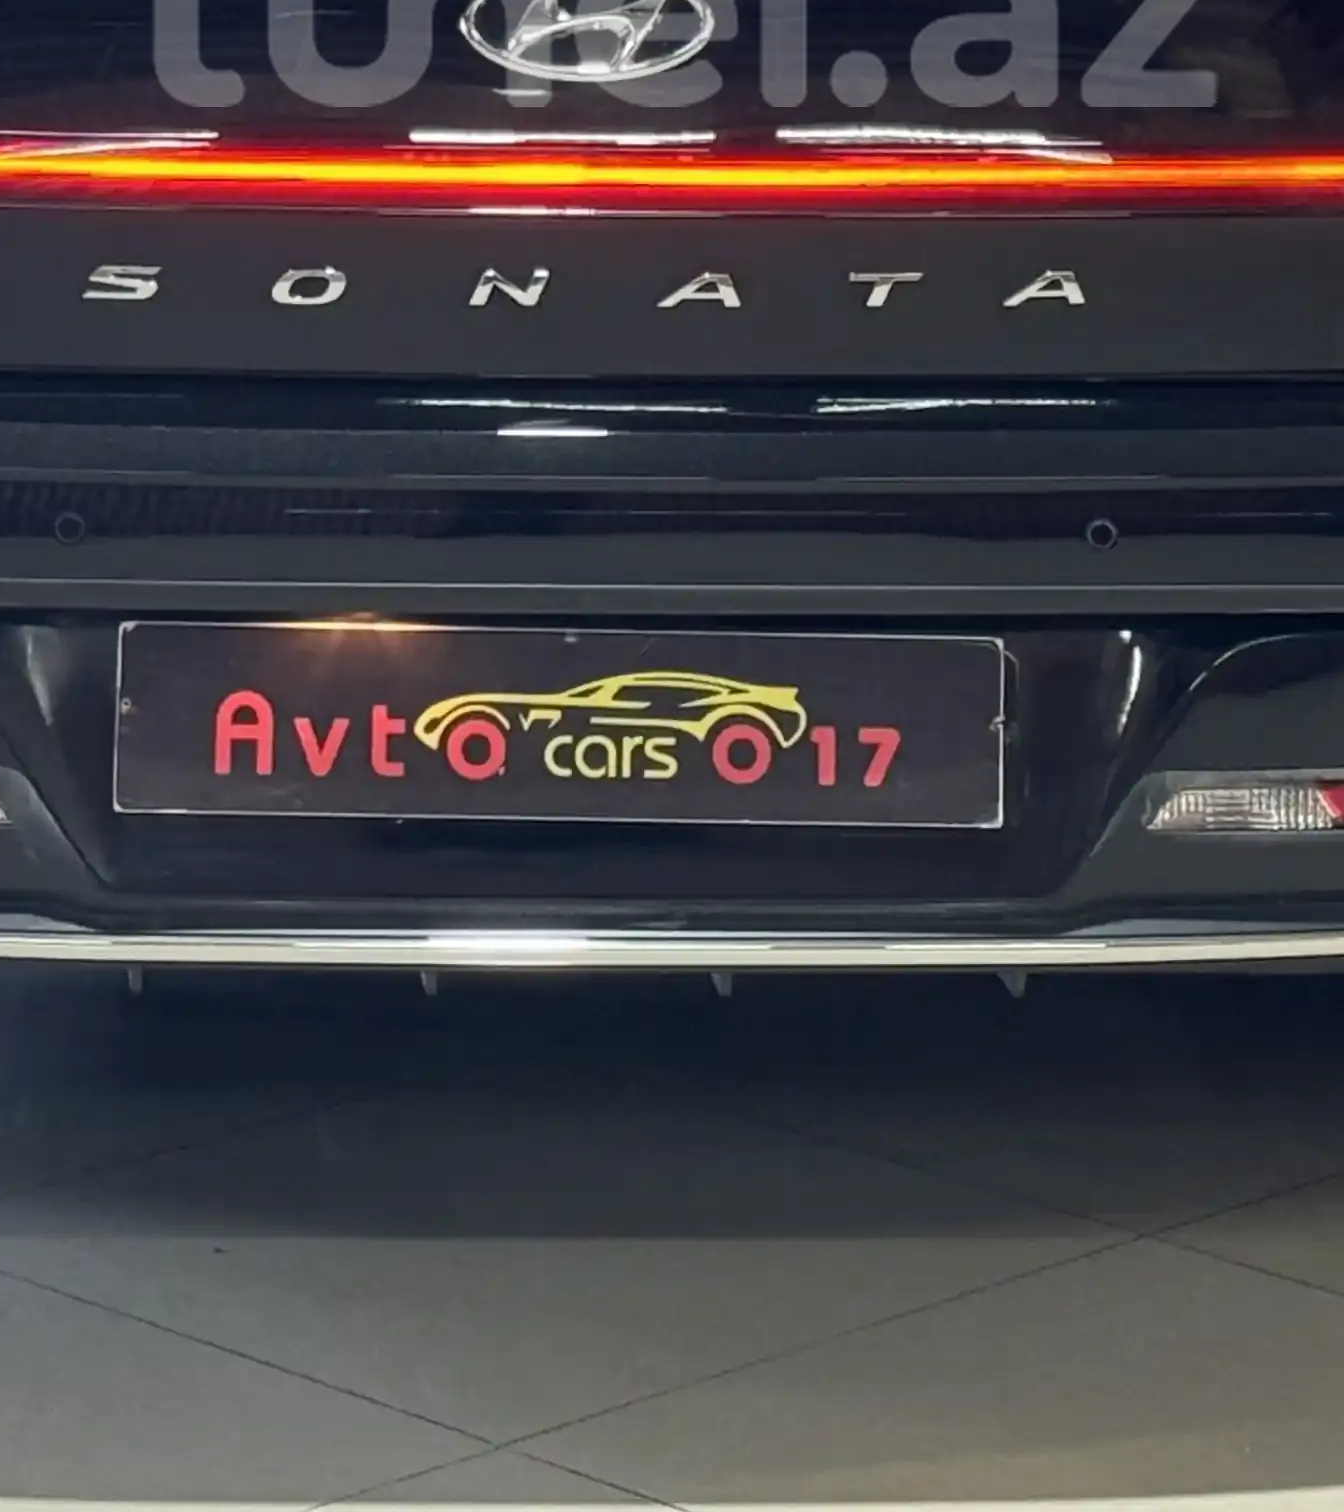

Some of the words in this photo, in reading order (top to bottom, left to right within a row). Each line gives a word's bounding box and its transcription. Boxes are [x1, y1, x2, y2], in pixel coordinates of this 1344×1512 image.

[82, 264, 1087, 309] SONATA
[213, 689, 506, 780] Avto
[543, 728, 679, 780] cars
